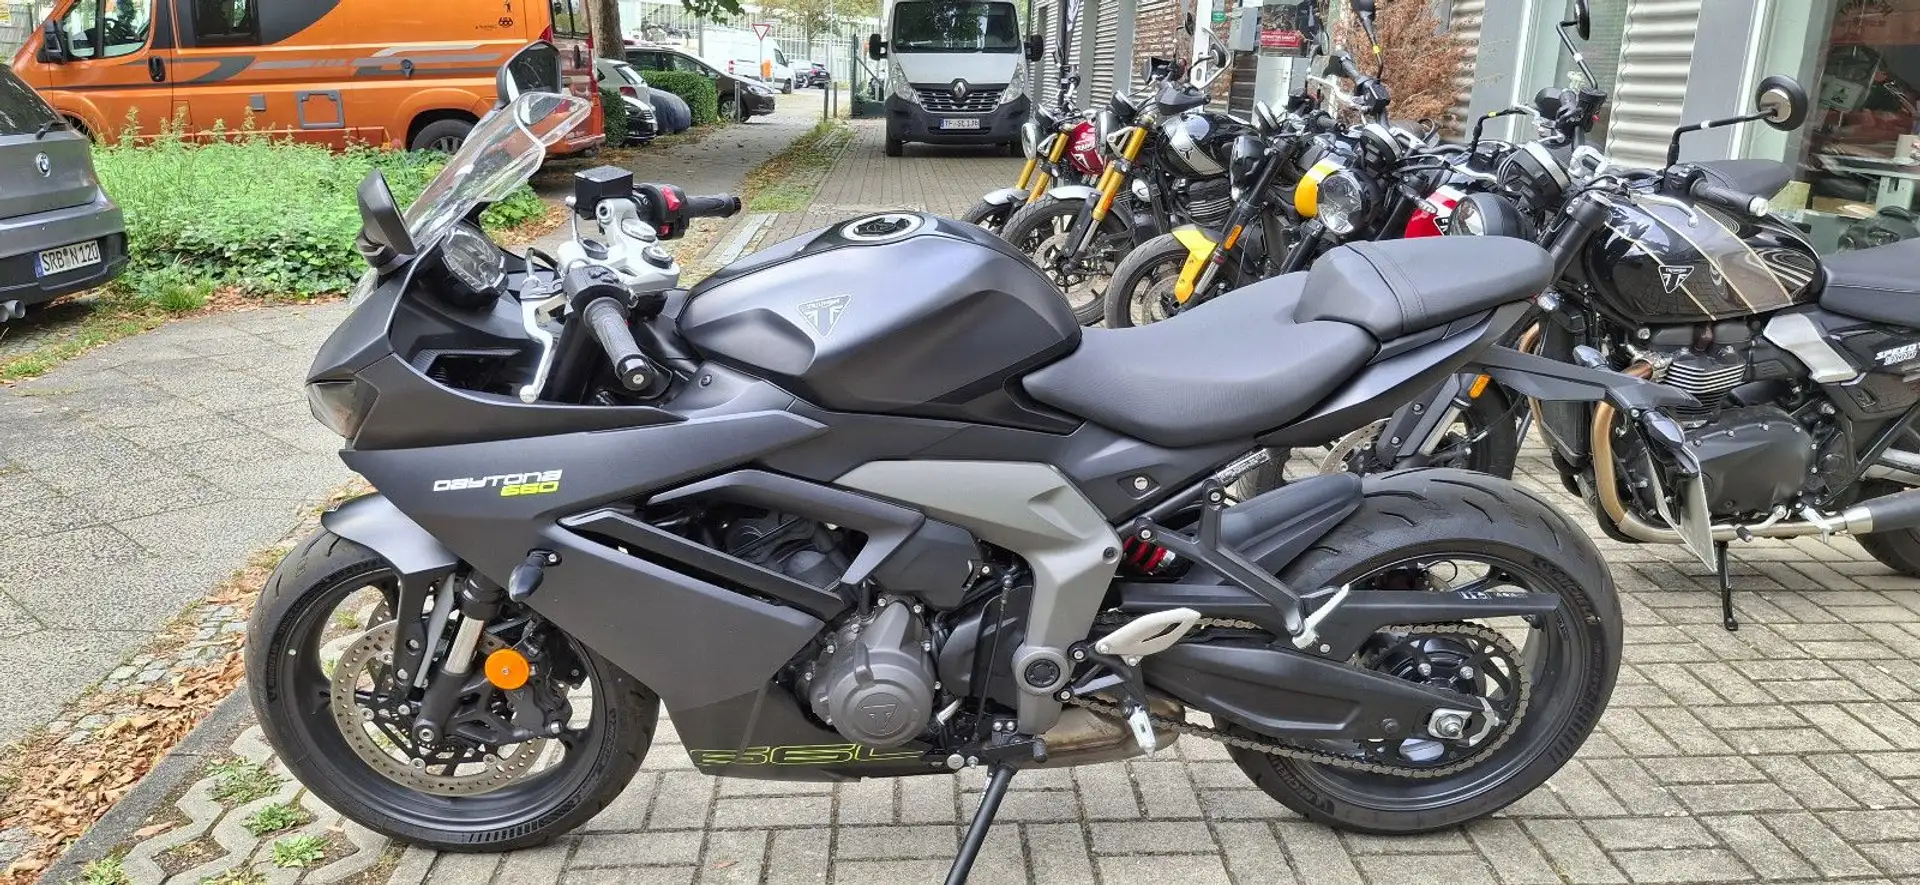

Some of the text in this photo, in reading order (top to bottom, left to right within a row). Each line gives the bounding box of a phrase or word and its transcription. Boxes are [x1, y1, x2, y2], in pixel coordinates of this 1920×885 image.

[42, 242, 99, 272] SRB N 120
[1875, 343, 1918, 360] SPEED
[500, 481, 560, 497] 660
